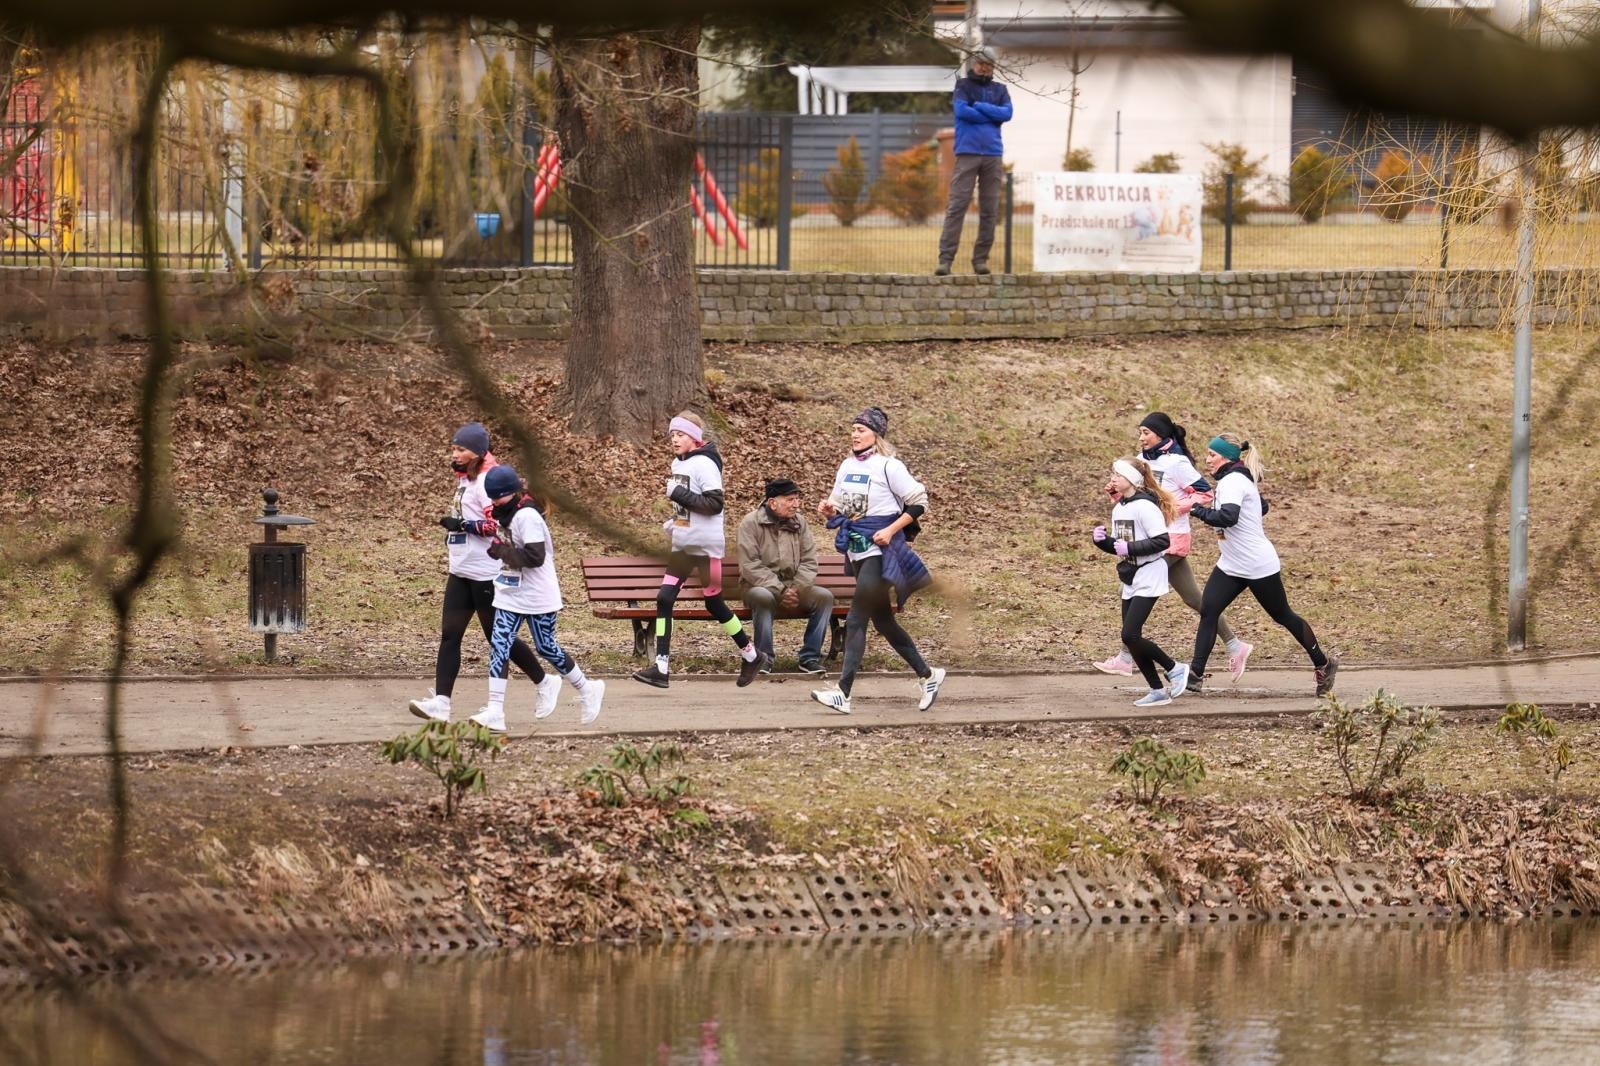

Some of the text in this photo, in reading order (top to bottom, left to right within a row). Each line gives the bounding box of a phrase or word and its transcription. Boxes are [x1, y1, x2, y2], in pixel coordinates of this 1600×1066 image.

[1054, 185, 1151, 202] REKRUTACJA
[1041, 214, 1105, 229] Przedszkole
[1107, 217, 1119, 229] nr
